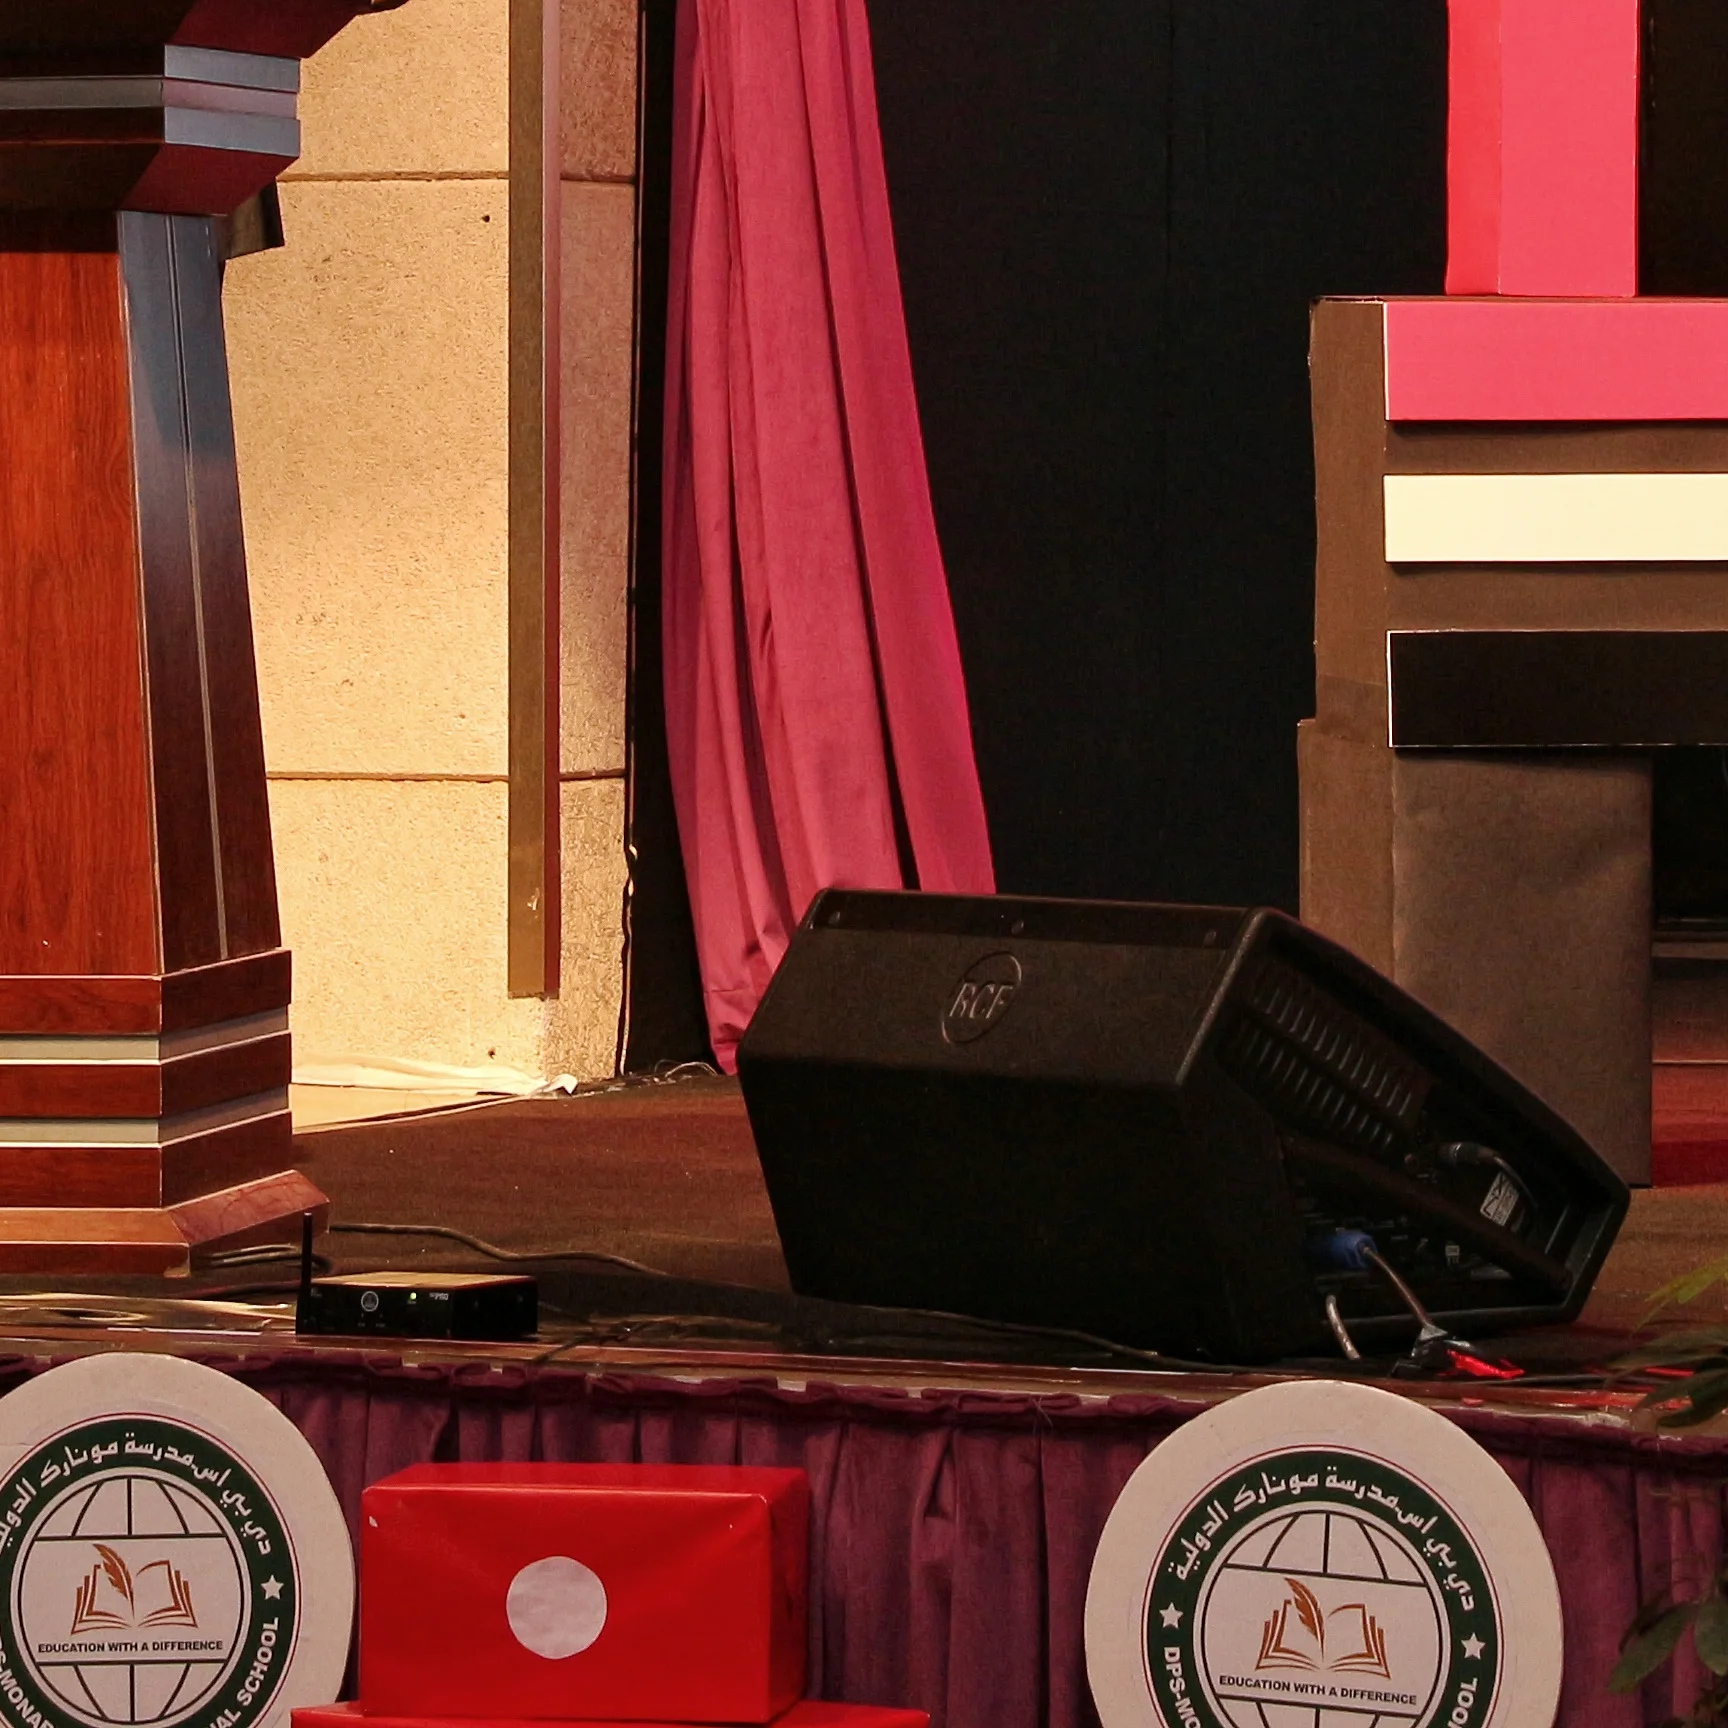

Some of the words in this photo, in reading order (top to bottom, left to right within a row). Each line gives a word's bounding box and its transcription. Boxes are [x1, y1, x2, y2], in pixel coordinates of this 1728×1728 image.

[1168, 1501, 1229, 1582] الدولية
[38, 1642, 105, 1654] EDUCATION
[108, 1641, 138, 1652] WITH
[140, 1641, 149, 1651] A
[152, 1640, 223, 1652] DIFFERENCE
[236, 1617, 279, 1707] SCHOOL
[1219, 1675, 1291, 1692] EDUCATION
[1294, 1682, 1327, 1695] WITH
[1329, 1687, 1337, 1697] A
[1340, 1688, 1418, 1705] DIFFERENCE
